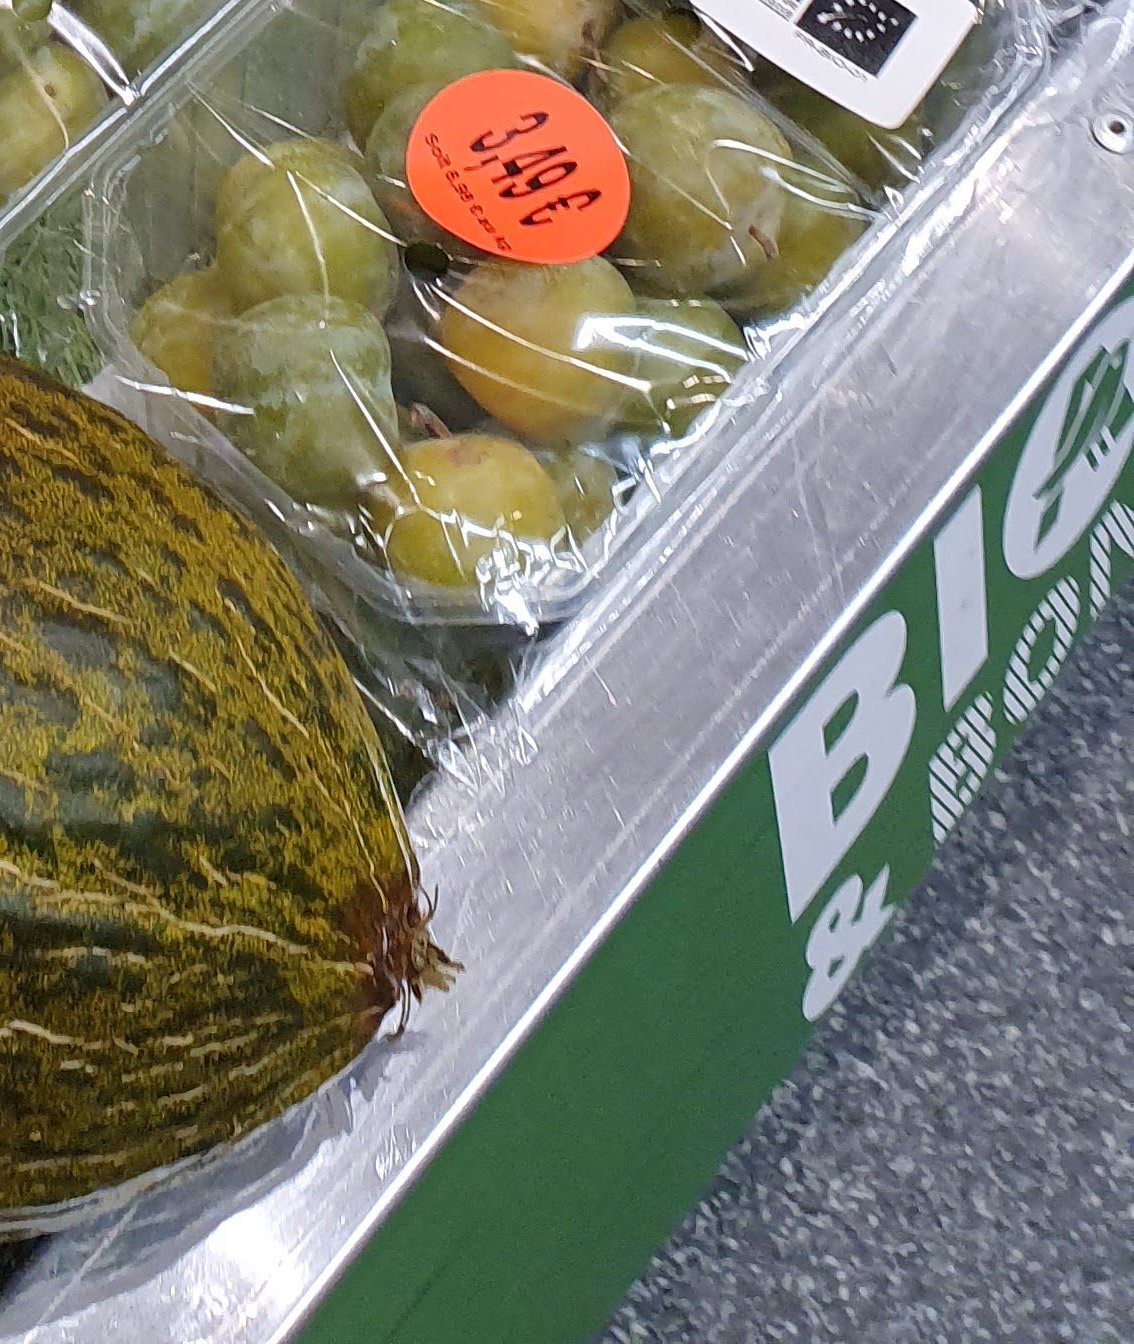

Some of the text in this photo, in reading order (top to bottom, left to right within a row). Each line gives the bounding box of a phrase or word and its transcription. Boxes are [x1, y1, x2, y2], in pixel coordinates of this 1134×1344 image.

[464, 114, 601, 225] 3,49 €
[803, 863, 896, 1021] &
